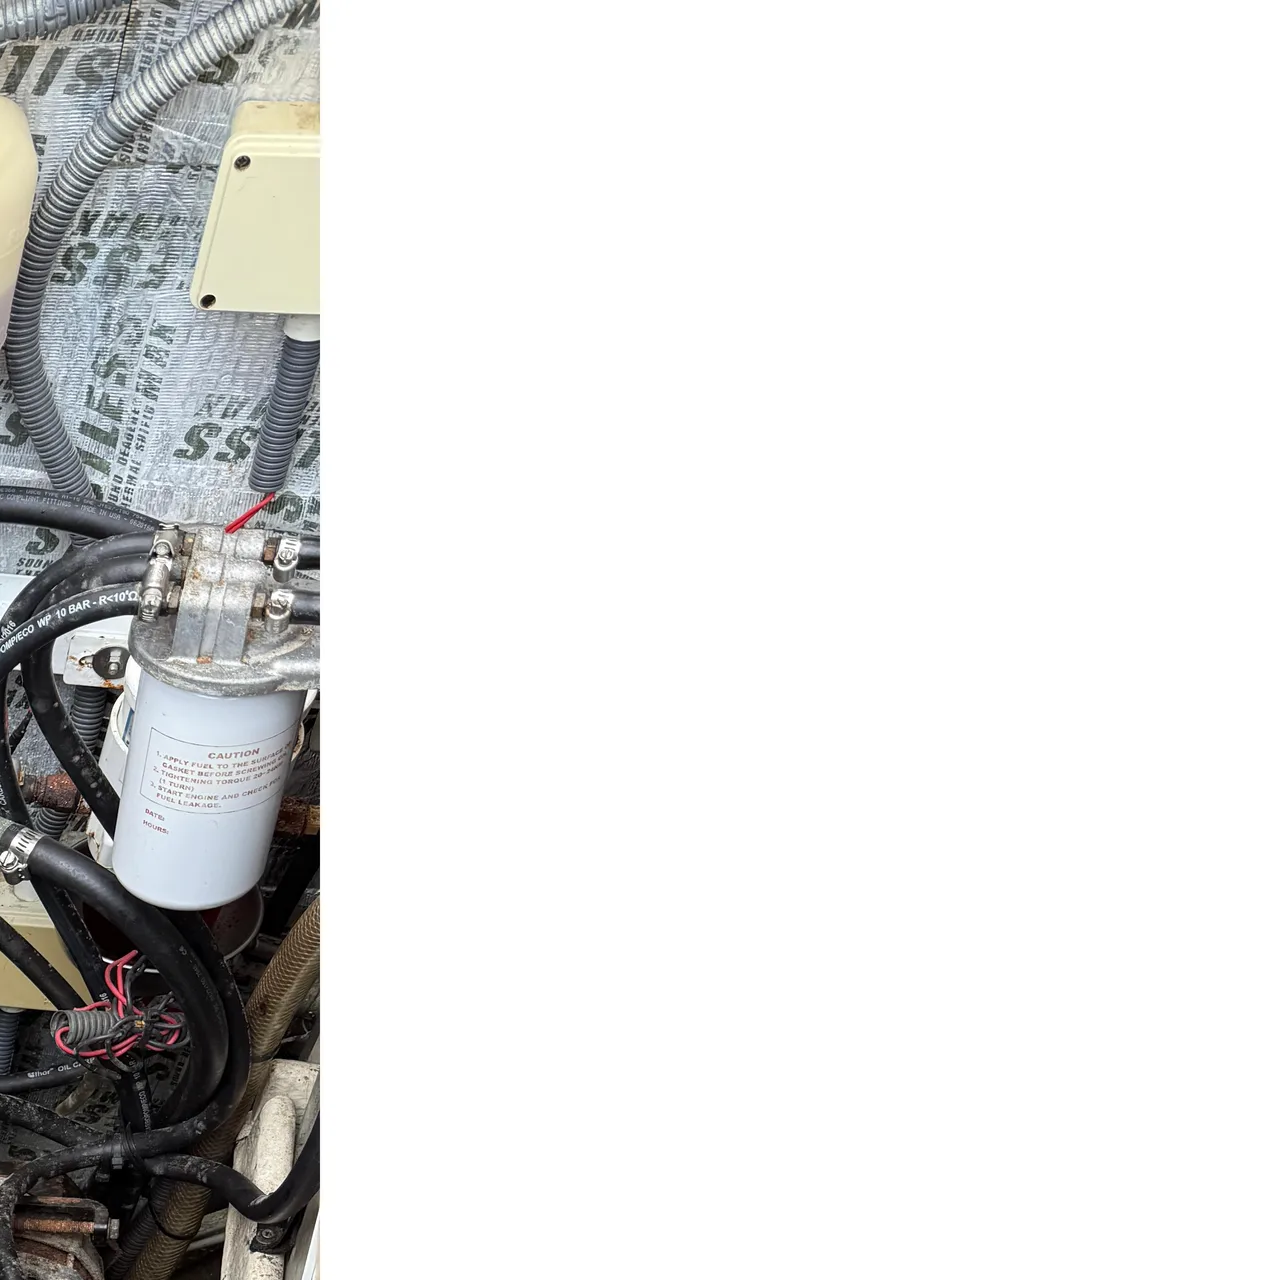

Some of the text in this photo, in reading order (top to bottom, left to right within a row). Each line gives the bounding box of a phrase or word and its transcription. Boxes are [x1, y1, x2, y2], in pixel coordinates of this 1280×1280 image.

[37, 614, 53, 628] WP
[56, 607, 67, 619] 10
[68, 599, 91, 615] BAR
[207, 747, 260, 760] CAUTION
[162, 762, 195, 776] GASKET
[235, 758, 277, 776] SCREWING
[163, 754, 190, 766] APPLY
[191, 762, 214, 770] FUEL
[160, 769, 252, 785] TIGHTENING TORQUE
[156, 792, 175, 805] FUEL
[157, 785, 183, 798] START
[185, 793, 219, 801] ENGINE
[221, 792, 240, 800] AND
[241, 783, 268, 797] CHECK
[142, 819, 169, 835] HOURS:
